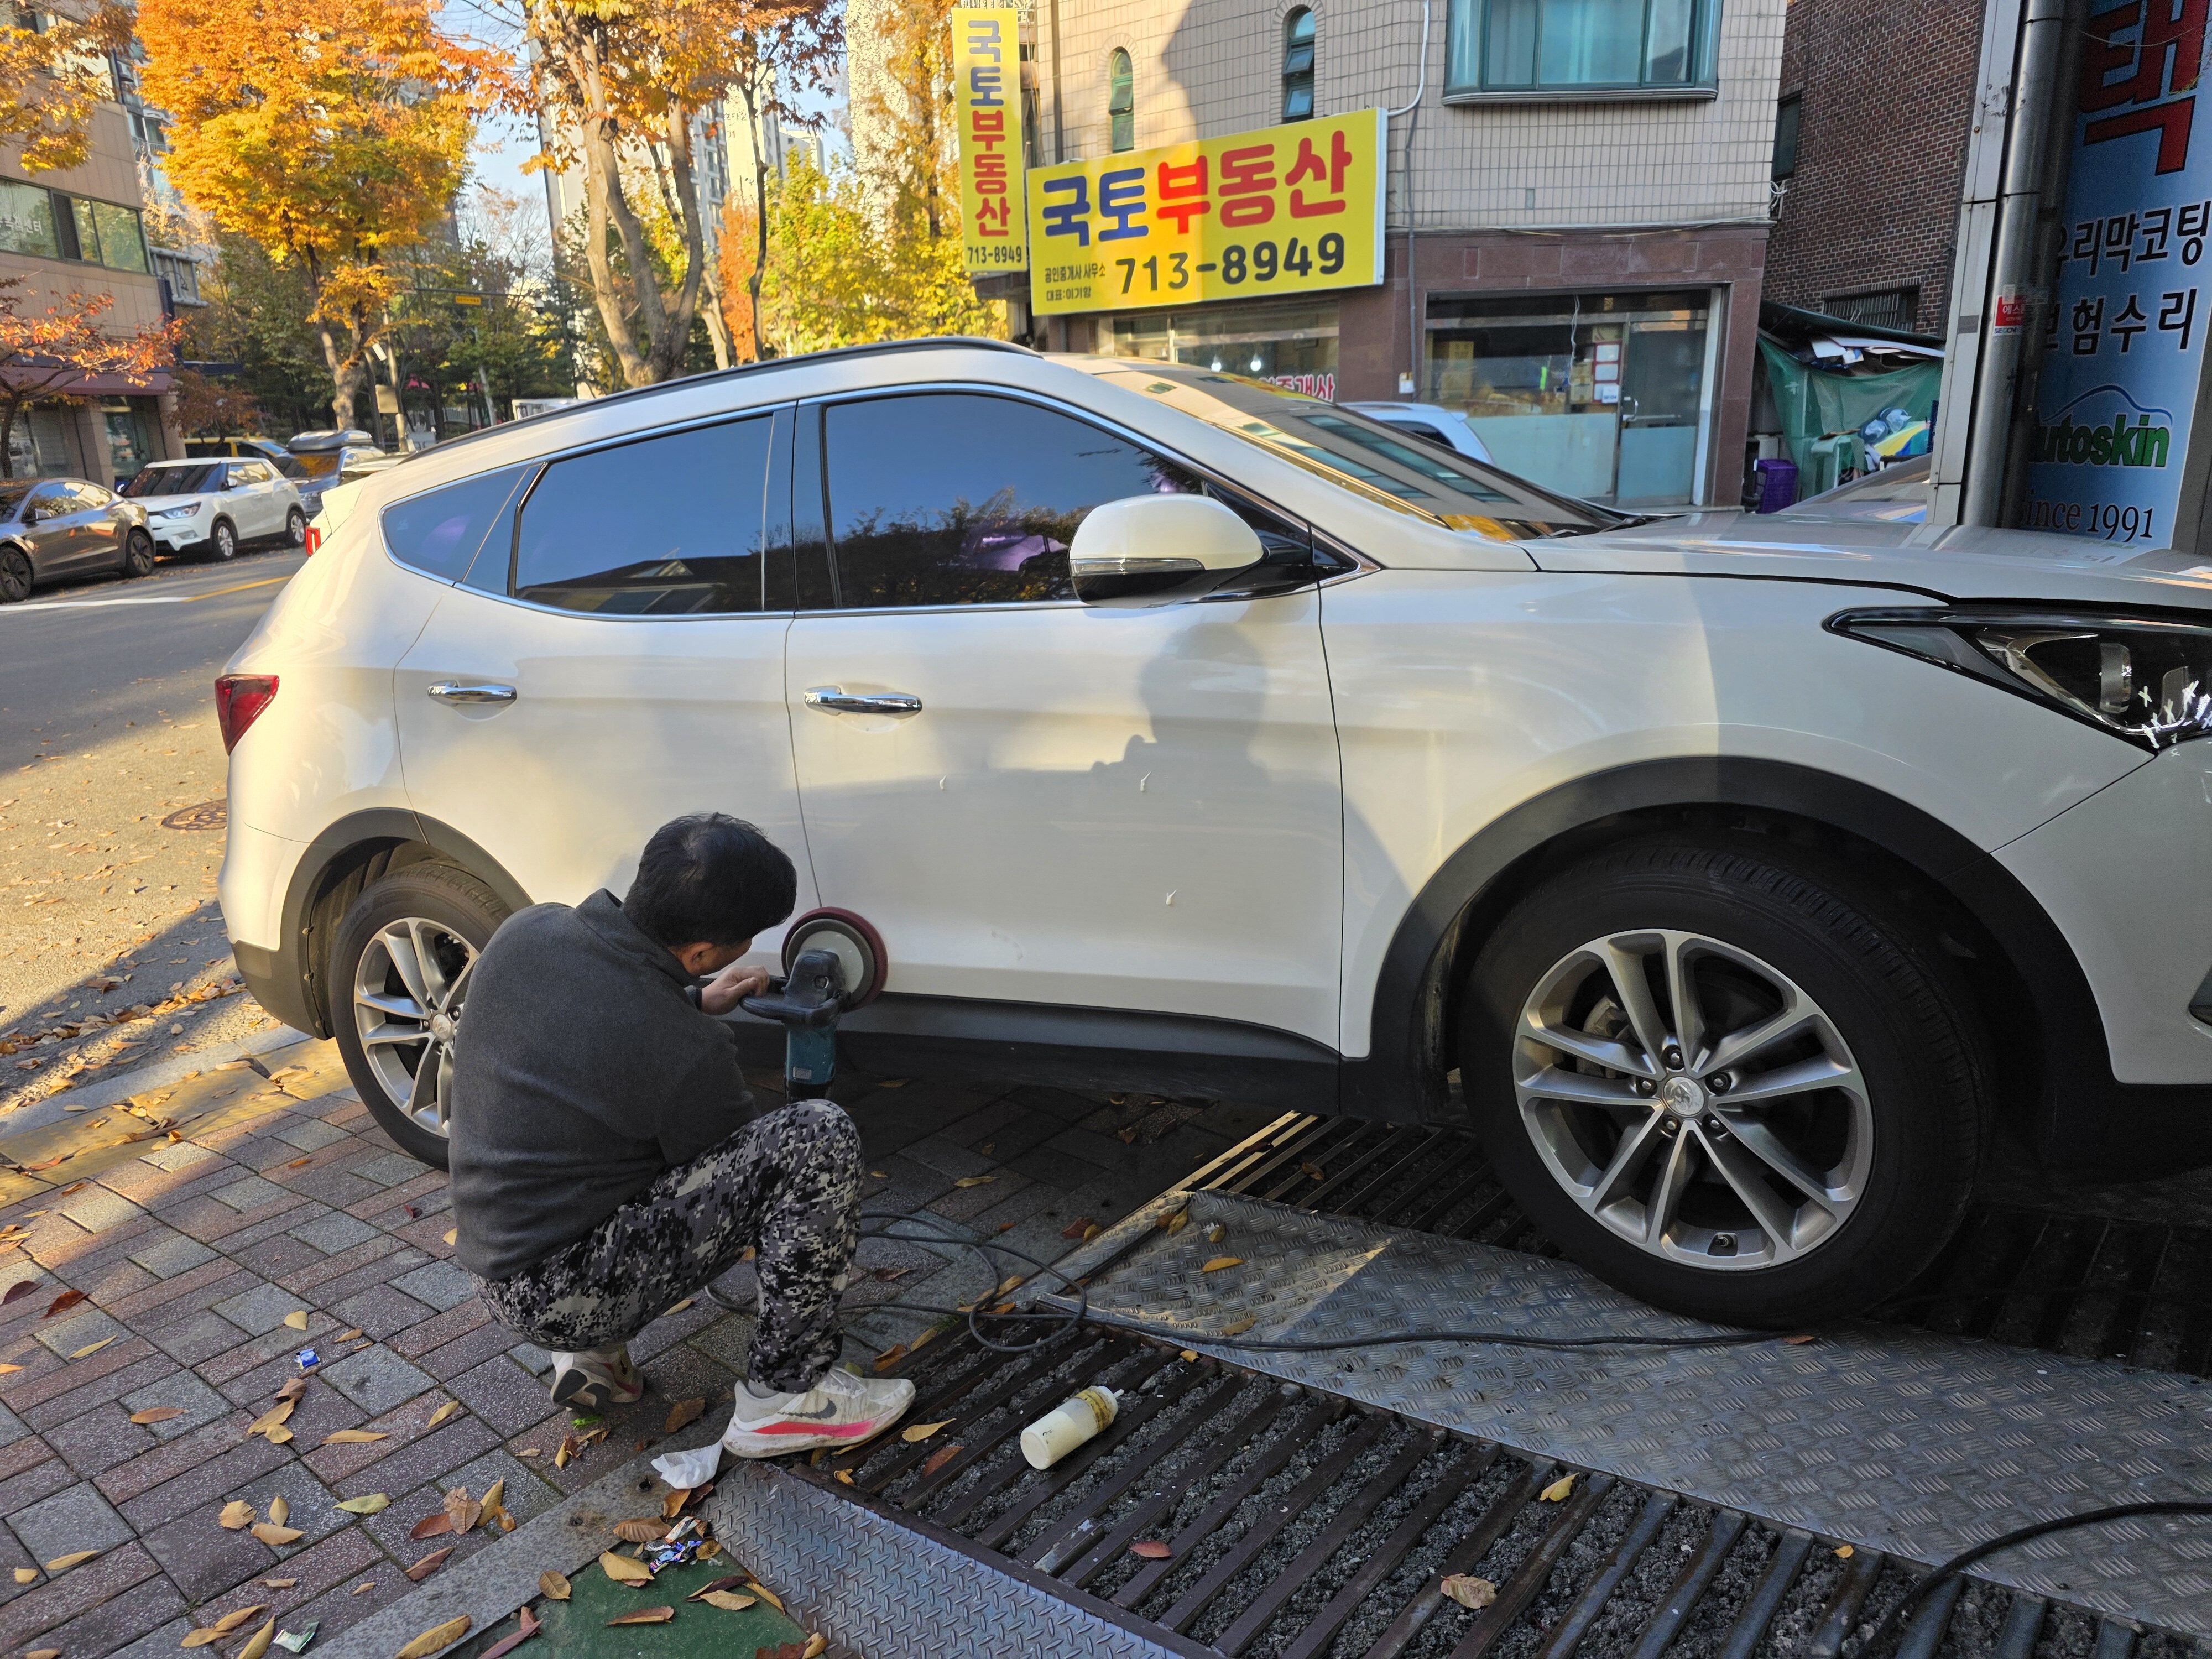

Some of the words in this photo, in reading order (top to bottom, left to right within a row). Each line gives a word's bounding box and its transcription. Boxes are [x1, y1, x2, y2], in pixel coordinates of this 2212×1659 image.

[967, 20, 1011, 237] 국토부동산
[1042, 129, 1353, 247] 국토부동산
[967, 246, 1022, 264] 713-8949
[1045, 265, 1082, 283] 공인중개사
[1083, 263, 1105, 279] 사무소
[1115, 232, 1345, 294] 713-8949
[2028, 414, 2170, 468] utoskin
[2086, 503, 2153, 543] 1991
